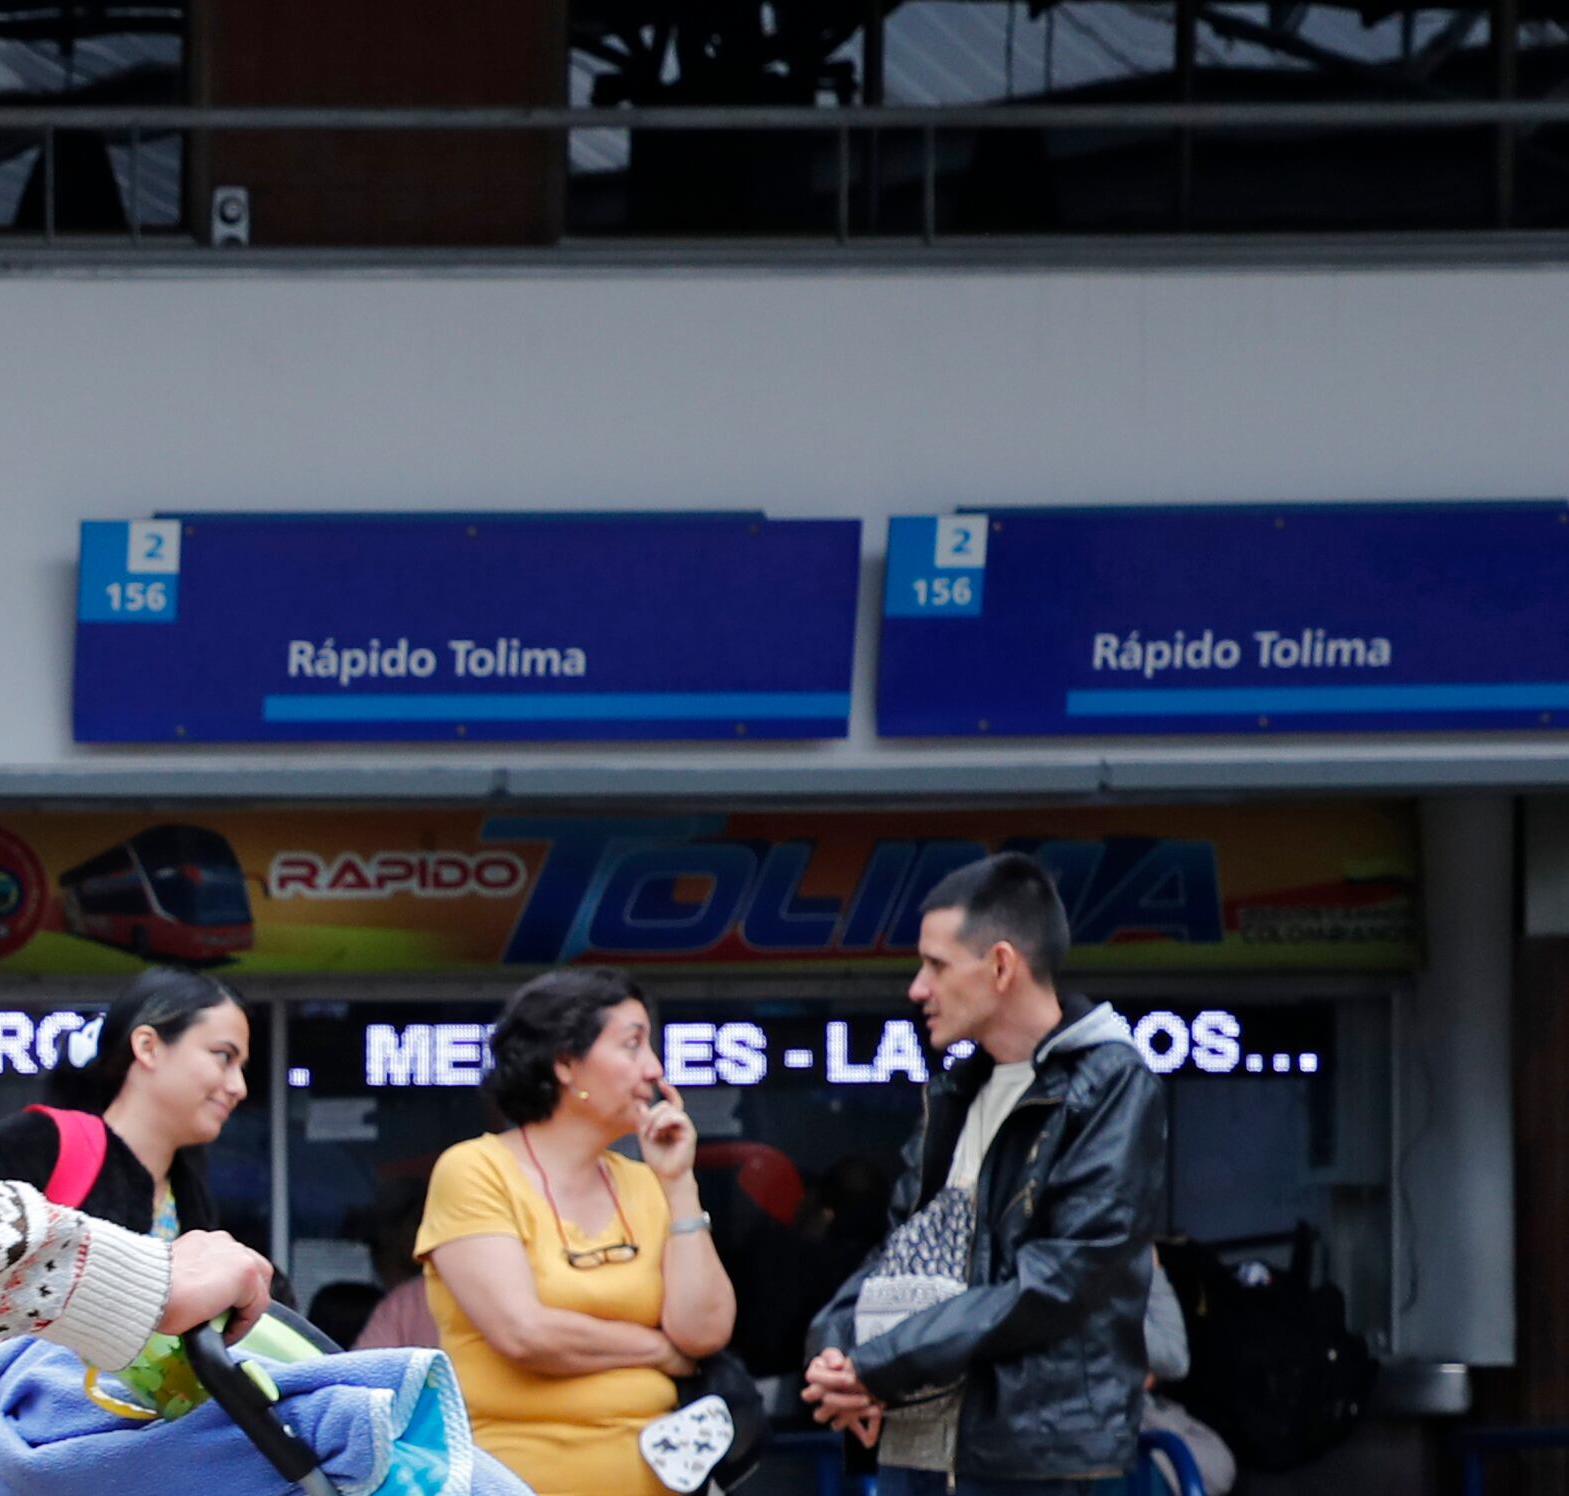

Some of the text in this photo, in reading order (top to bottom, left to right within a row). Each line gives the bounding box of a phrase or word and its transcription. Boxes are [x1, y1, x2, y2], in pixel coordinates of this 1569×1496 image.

[144, 533, 165, 559] 2
[950, 527, 973, 554] 2
[105, 581, 167, 612] 156
[912, 576, 972, 606] 156
[287, 637, 587, 687] Rápido Tolima
[1092, 628, 1392, 679] Rápido Tolima
[271, 852, 526, 897] RAPIDO
